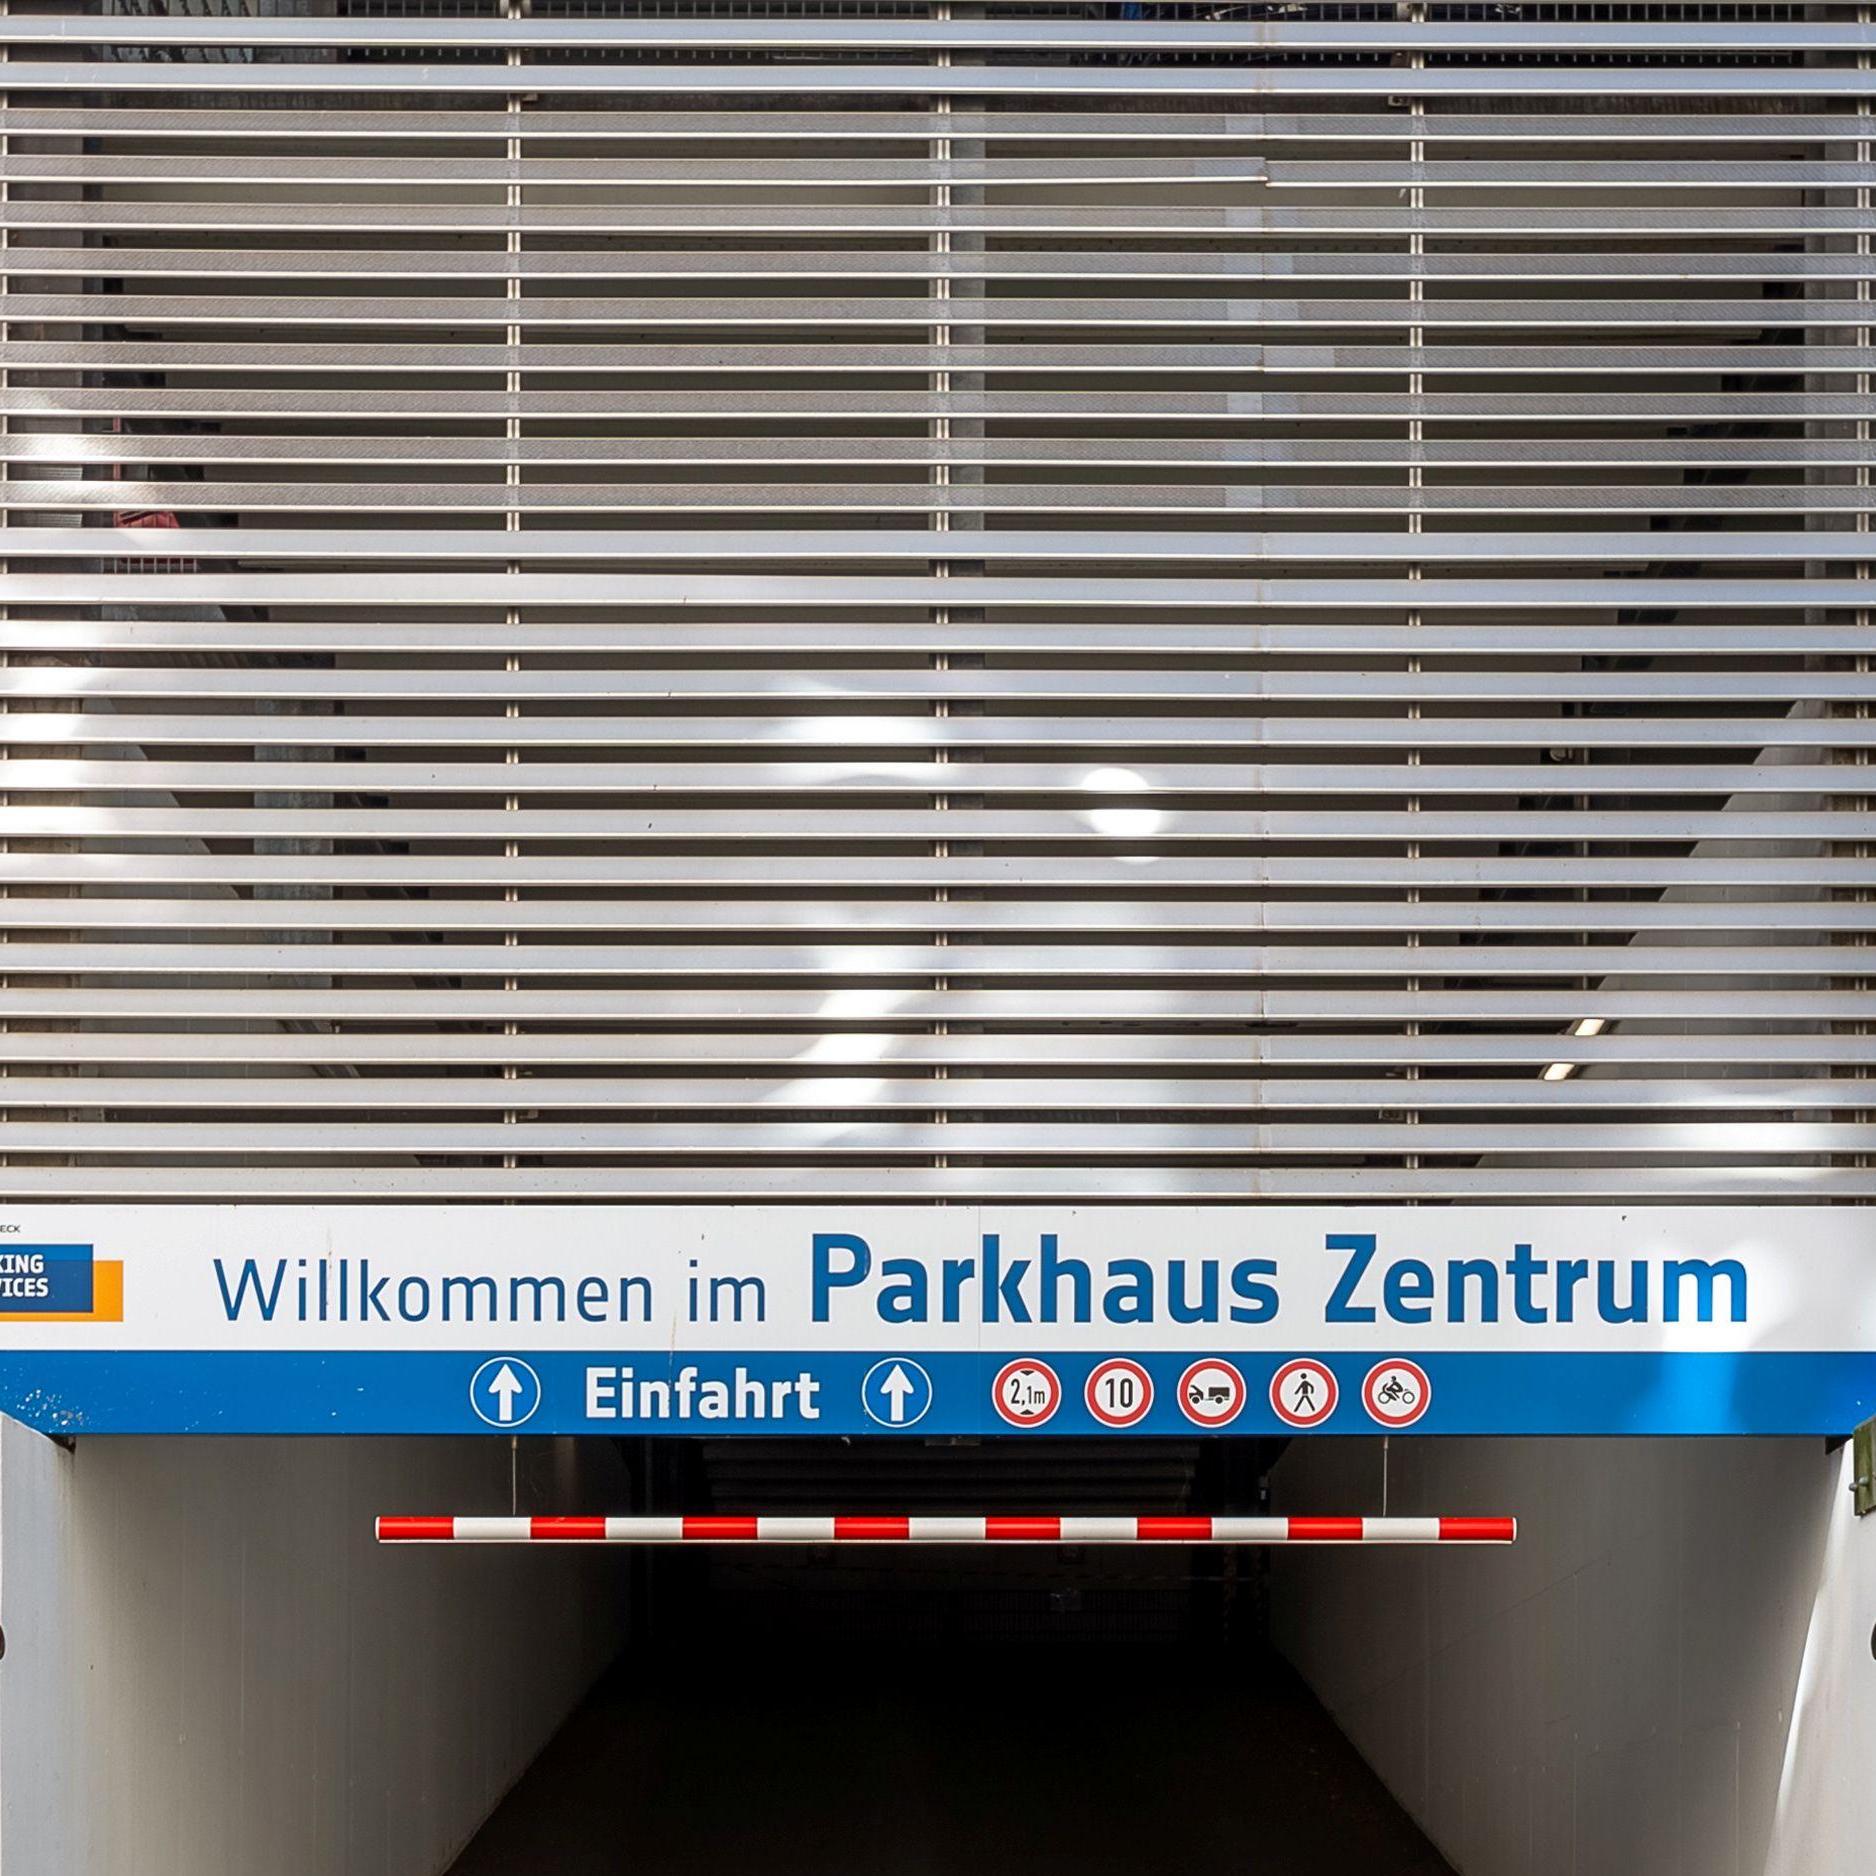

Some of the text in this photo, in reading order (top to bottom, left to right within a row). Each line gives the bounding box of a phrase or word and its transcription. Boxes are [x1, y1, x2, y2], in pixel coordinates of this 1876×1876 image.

[213, 1233, 1749, 1324] Willkommen im Parkhaus Zentrum
[585, 1366, 821, 1419] Einfahrt
[1105, 1378, 1134, 1408] 10
